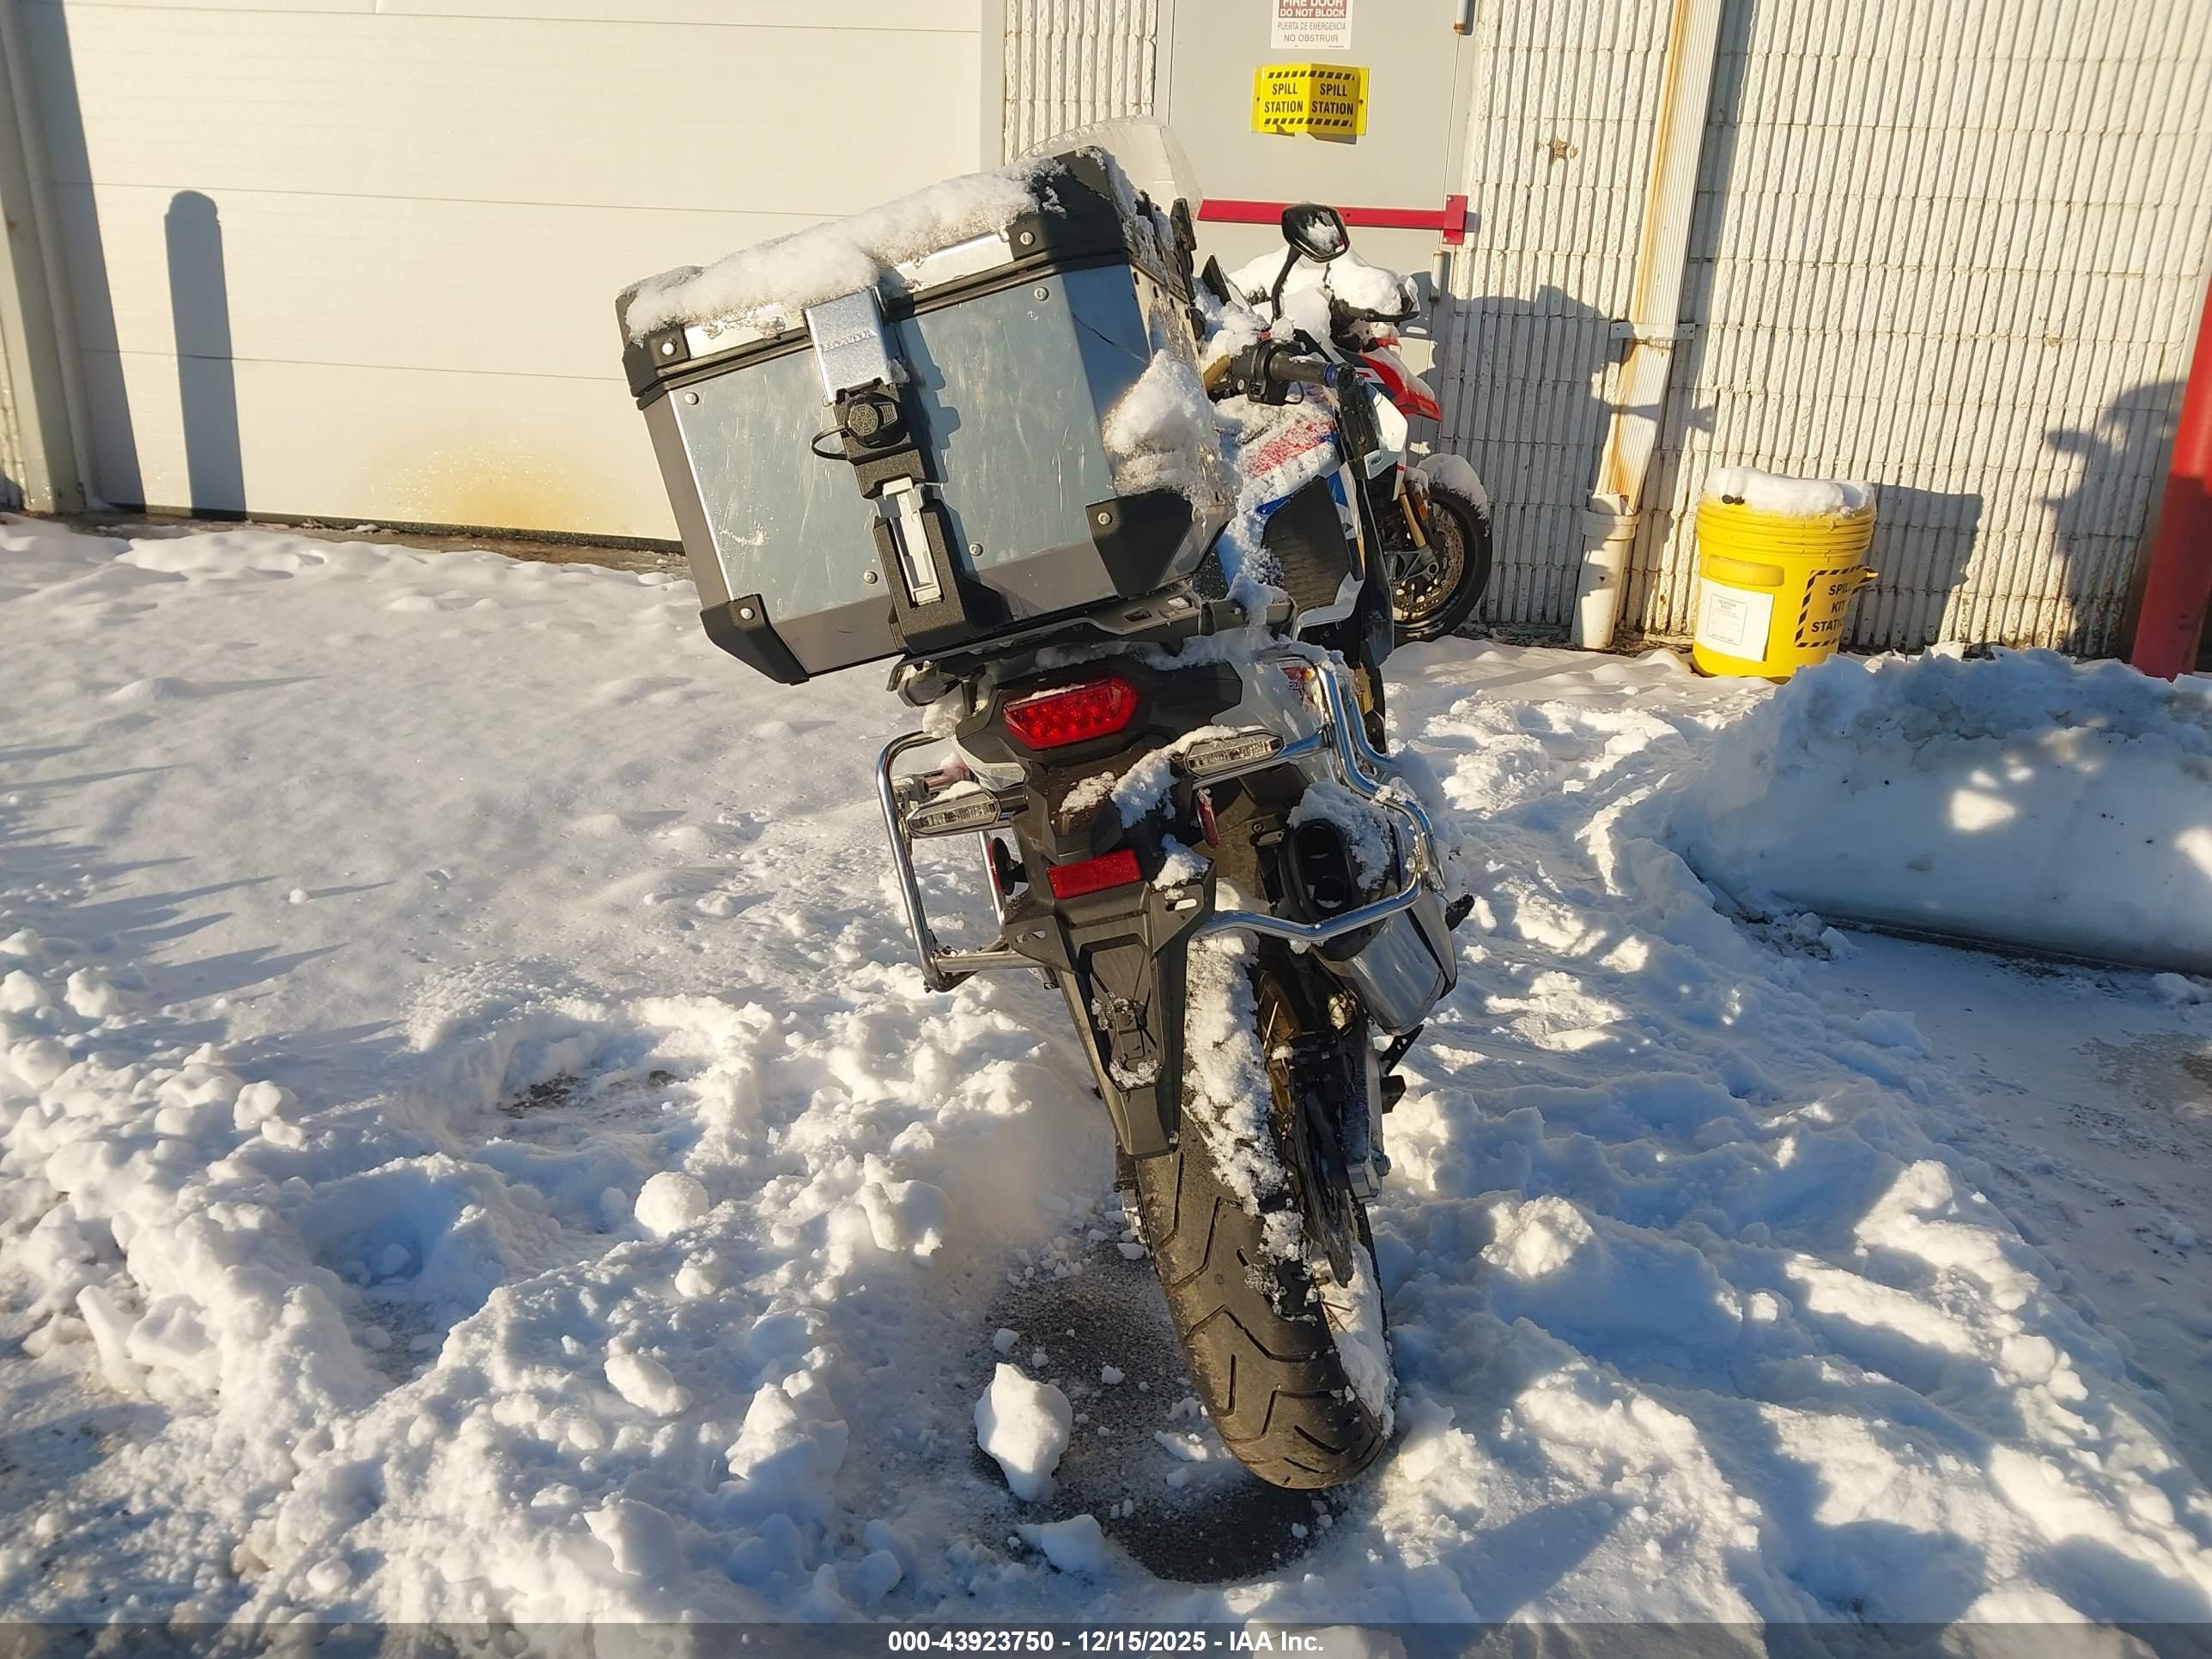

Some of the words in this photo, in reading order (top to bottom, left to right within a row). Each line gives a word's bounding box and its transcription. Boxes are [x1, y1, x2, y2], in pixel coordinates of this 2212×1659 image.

[1279, 8, 1293, 17] DO
[1295, 8, 1314, 17] NOT
[1315, 8, 1346, 17] BLOCK
[1278, 21, 1299, 31] PUERTA
[1300, 21, 1309, 31] DE
[1310, 21, 1346, 31] EMERGENCIA
[1284, 33, 1296, 42] NO
[1297, 33, 1339, 42] OBSTRUIR
[1272, 82, 1297, 95] SPILL
[1319, 82, 1347, 97] SPILL
[1264, 100, 1304, 113] STATION
[1311, 100, 1354, 115] STATION
[821, 329, 877, 353] HONDA
[1831, 600, 1846, 613] KIT
